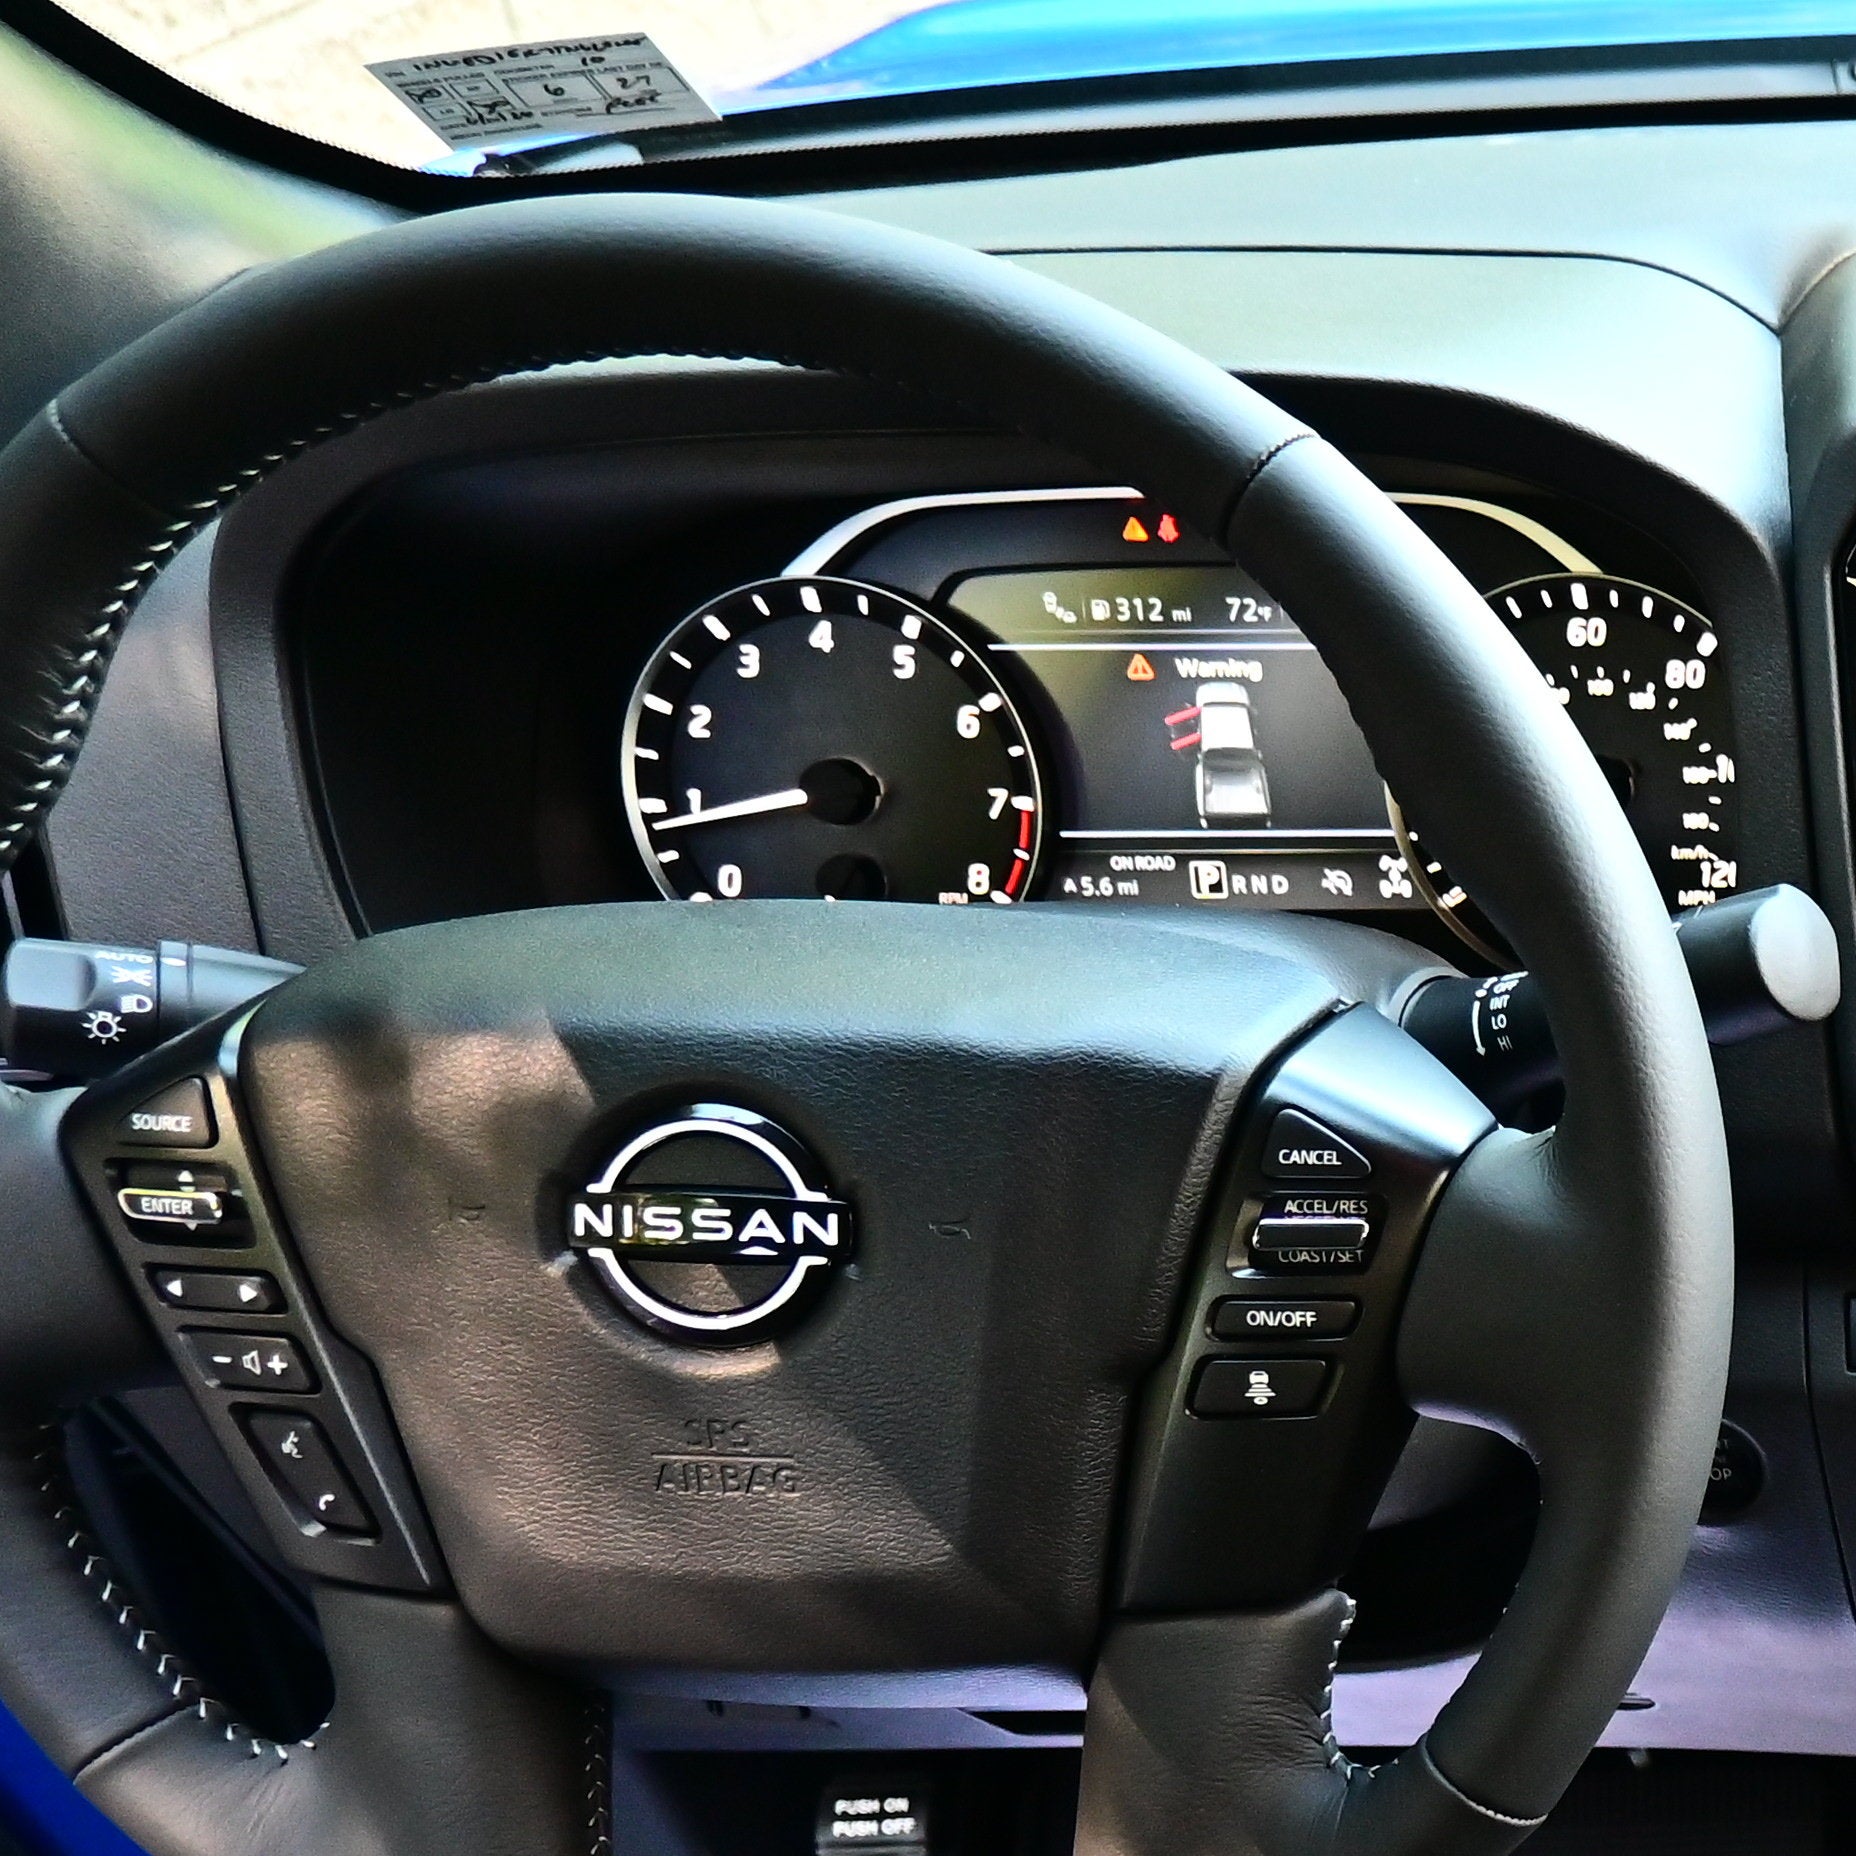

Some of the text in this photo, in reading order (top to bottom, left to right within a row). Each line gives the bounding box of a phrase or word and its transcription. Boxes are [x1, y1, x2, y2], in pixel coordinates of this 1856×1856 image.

[1117, 597, 1164, 622] 312
[1172, 607, 1192, 622] mi
[808, 619, 834, 653] 4
[1567, 617, 1607, 647] 60
[737, 644, 760, 678] 3
[894, 645, 916, 679] 5
[1174, 658, 1263, 682] Warning
[1665, 659, 1706, 689] 80
[687, 704, 712, 739] 2
[957, 704, 981, 739] 6
[987, 787, 1009, 819] 7
[1136, 855, 1176, 872] ROAD
[718, 864, 742, 897] 0
[967, 863, 990, 895] 8
[1232, 874, 1249, 895] R
[1251, 874, 1268, 895] N
[1272, 874, 1290, 895] D
[95, 950, 153, 964] AUTO
[1491, 1014, 1508, 1031] LO
[1497, 1035, 1513, 1053] HI
[131, 1113, 192, 1134] SOURCE
[1278, 1149, 1342, 1167] CANCEL
[141, 1197, 194, 1217] ENTER
[1283, 1199, 1369, 1216] ACCEL/RES
[574, 1203, 839, 1246] NISSAN
[1246, 1310, 1318, 1328] ON/OFF
[655, 1463, 801, 1496] AIRBAG
